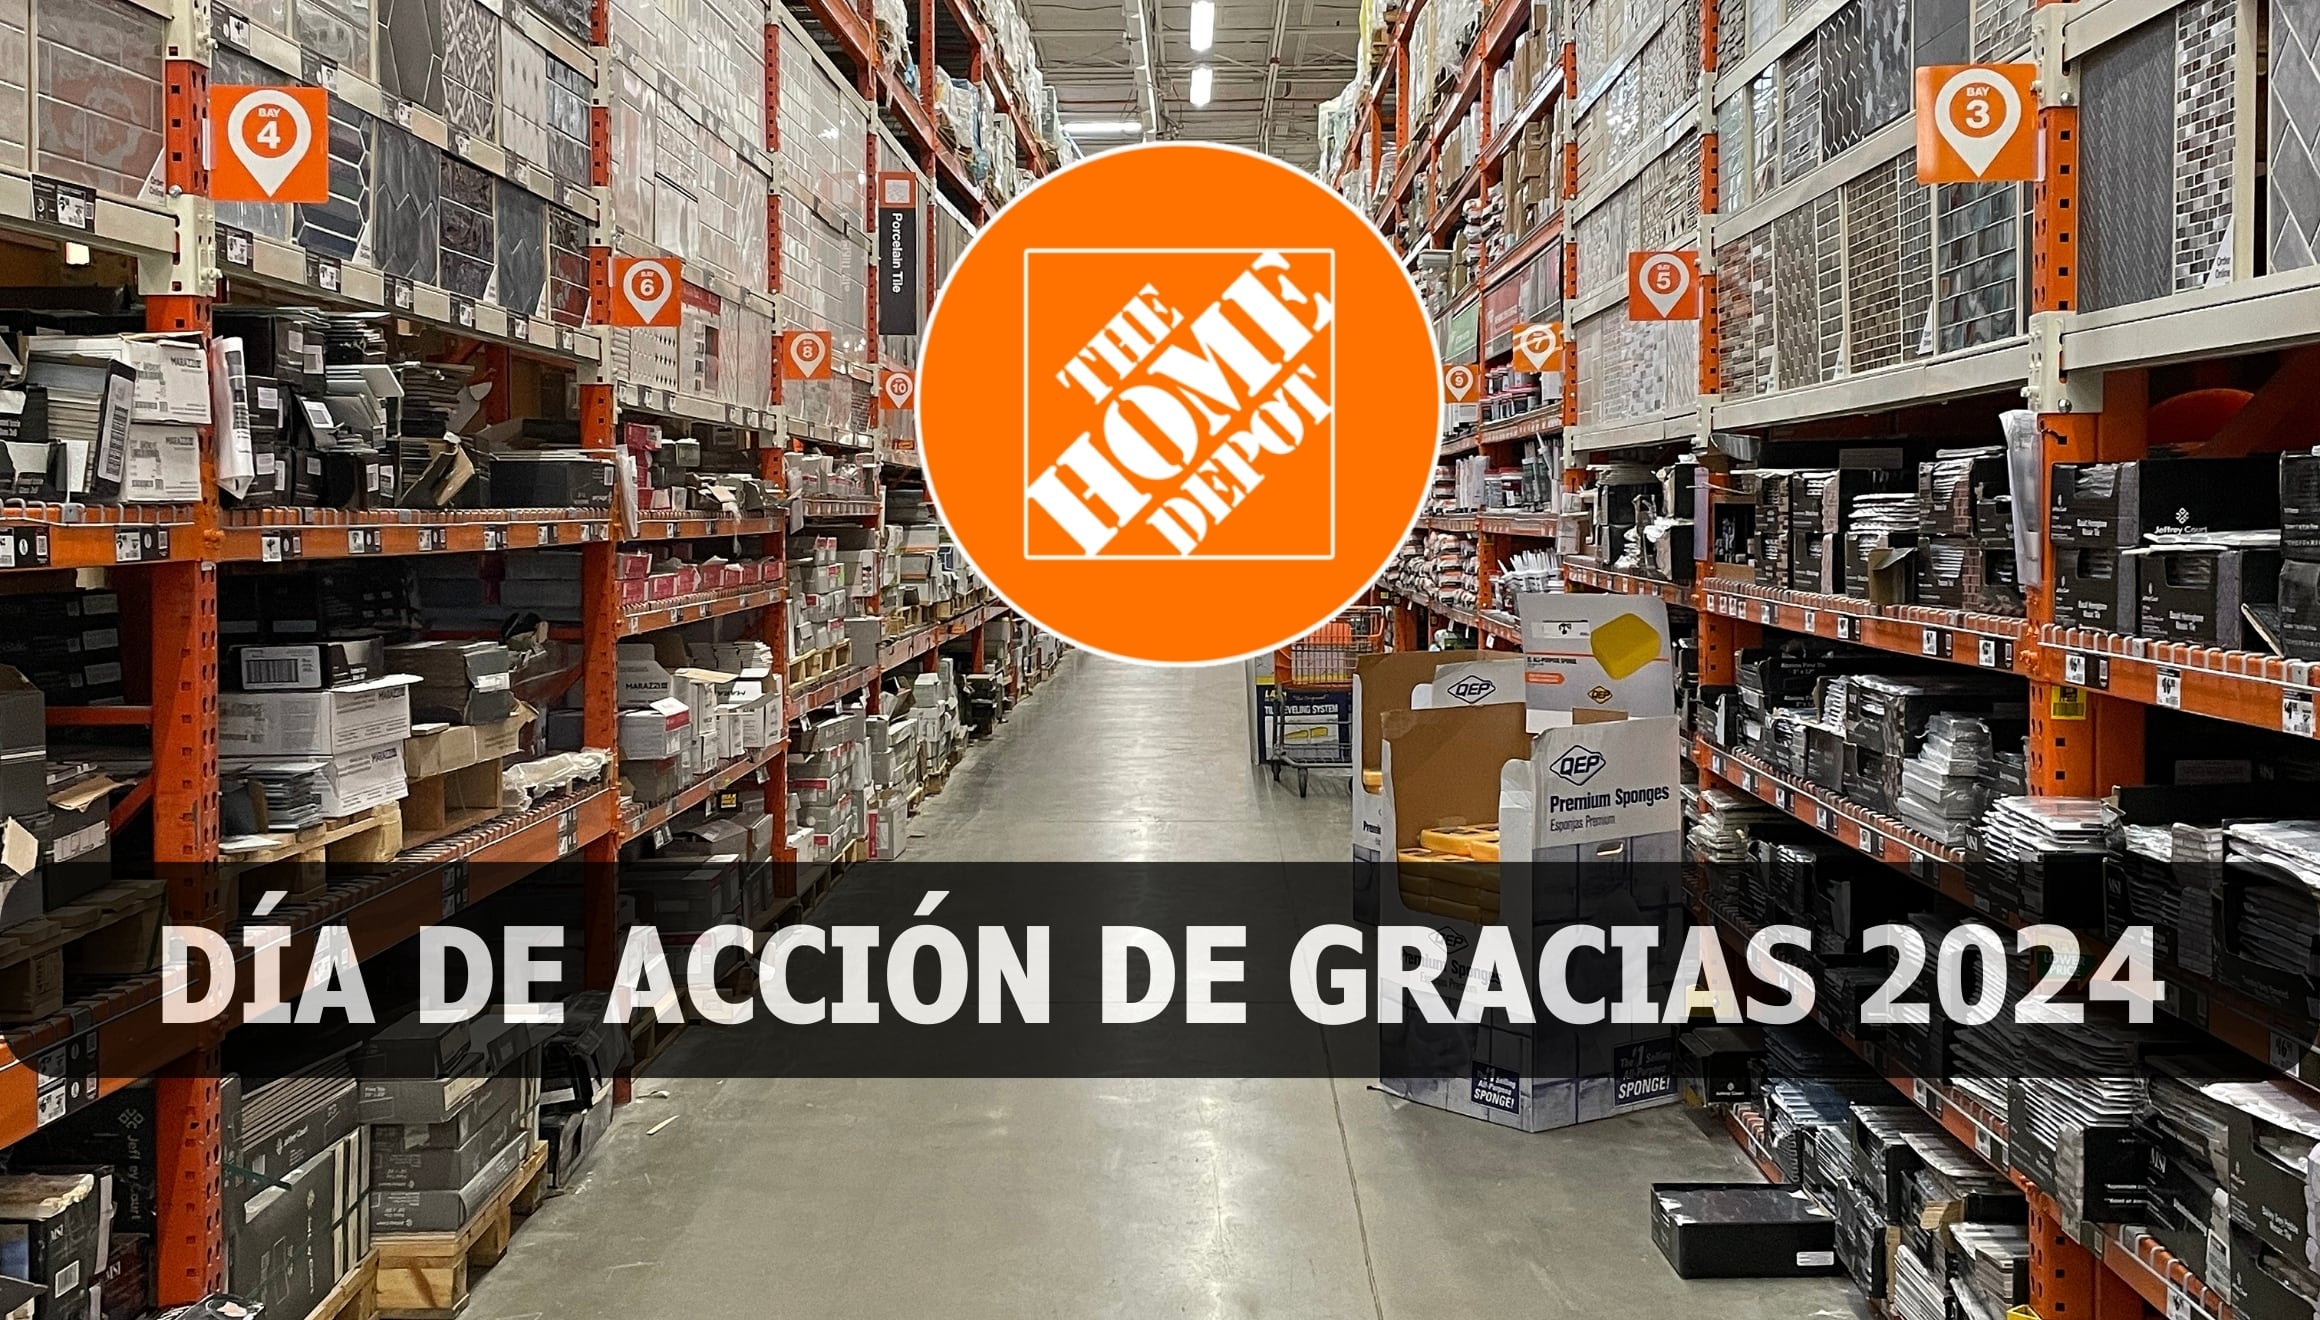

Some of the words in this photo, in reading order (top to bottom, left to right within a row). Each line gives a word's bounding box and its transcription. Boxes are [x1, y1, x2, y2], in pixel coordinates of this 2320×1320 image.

[1965, 87, 1990, 97] BAY
[258, 107, 281, 118] BAY
[1965, 99, 1991, 129] 3
[256, 120, 281, 150] 4
[890, 211, 905, 269] Porcelain
[640, 278, 655, 297] 6
[892, 271, 904, 294] Tile
[1655, 272, 1672, 290] 5
[1532, 335, 1546, 350] 7
[802, 345, 814, 359] 8
[891, 383, 906, 394] 10
[1454, 375, 1464, 387] 9
[2154, 525, 2183, 536] Jeffrey
[1456, 682, 1491, 697] QEP
[1312, 703, 1338, 714] SYSTEM
[1560, 755, 1600, 777] QEP
[1550, 791, 1611, 814] Premium
[1615, 785, 1670, 809] Sponges
[1585, 814, 1616, 828] Premium
[2043, 953, 2087, 966] LOWER
[2049, 963, 2082, 977] PRICE
[1618, 1075, 1671, 1099] SPONGE!
[1473, 1087, 1516, 1109] SPONGE!
[126, 1134, 141, 1180] Jeffey
